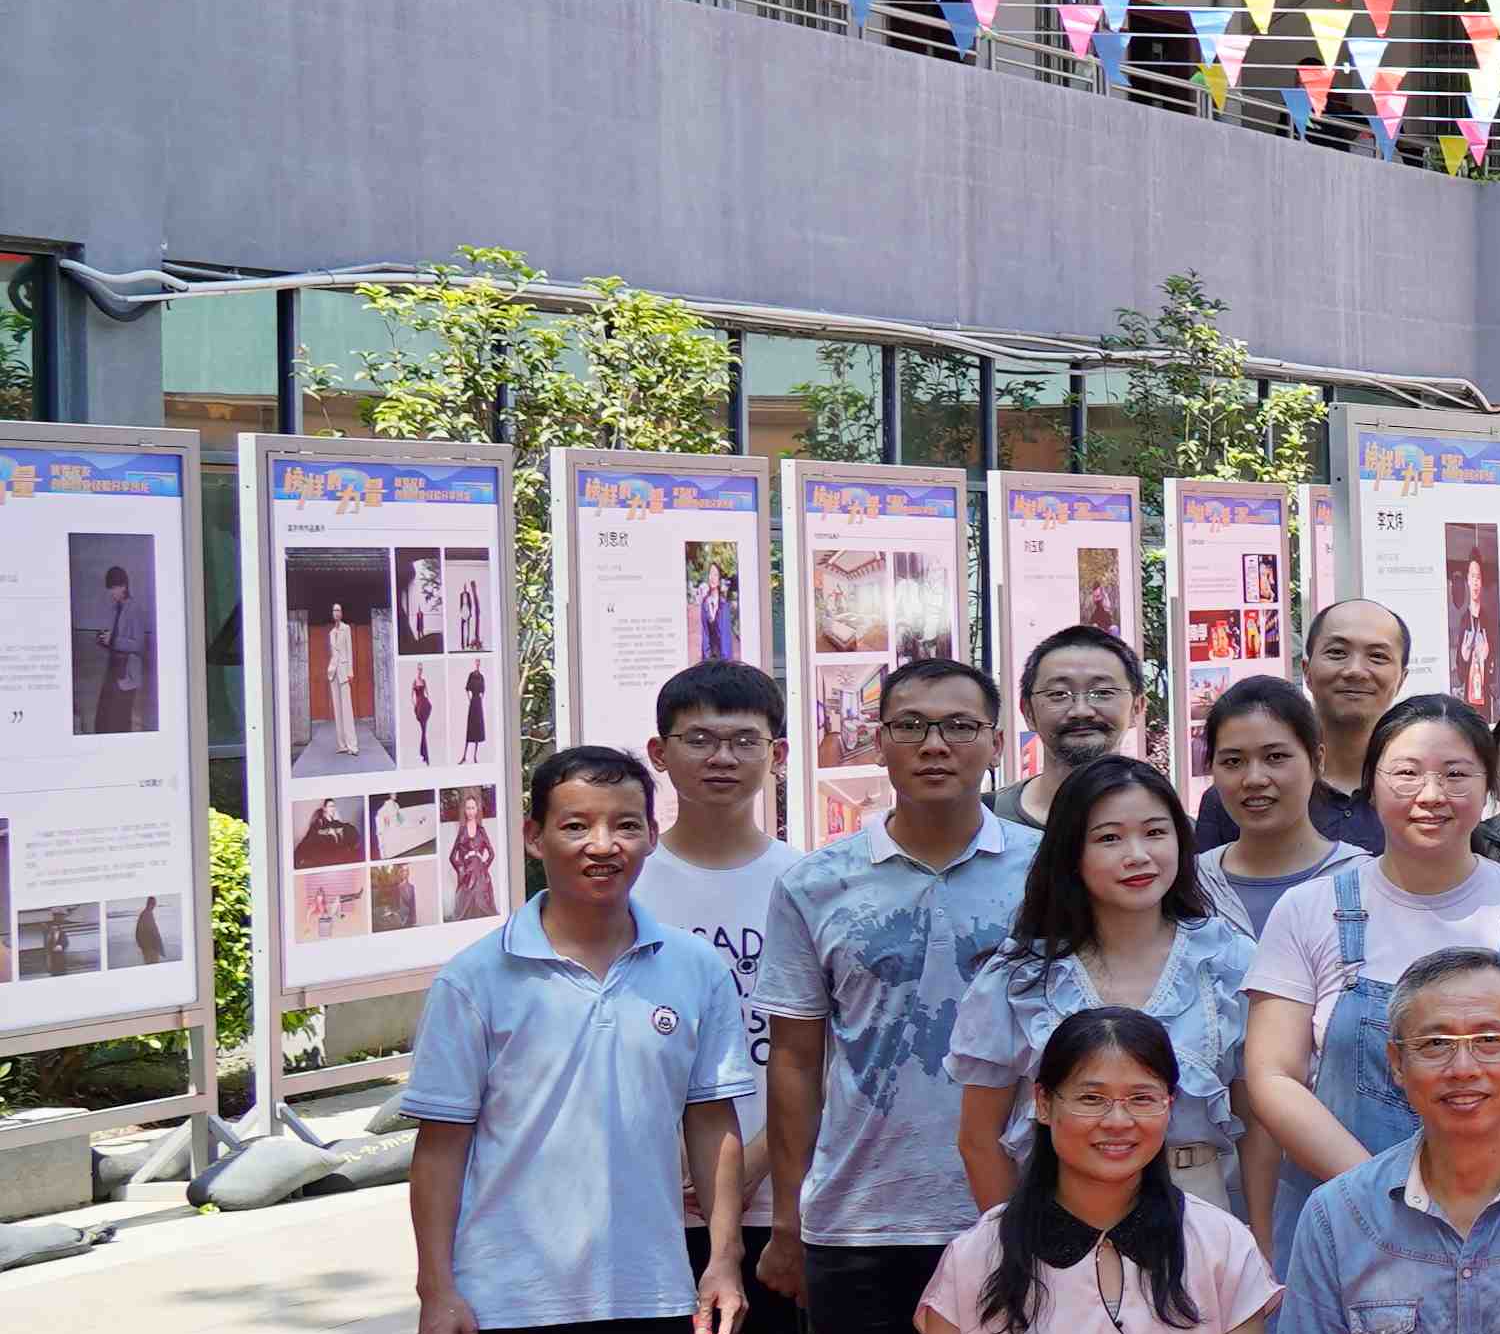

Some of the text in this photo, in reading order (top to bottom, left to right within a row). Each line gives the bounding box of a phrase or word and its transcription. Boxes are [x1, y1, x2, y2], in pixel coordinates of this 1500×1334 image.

[284, 467, 388, 515] 榜样的力量
[692, 926, 764, 960] AD
